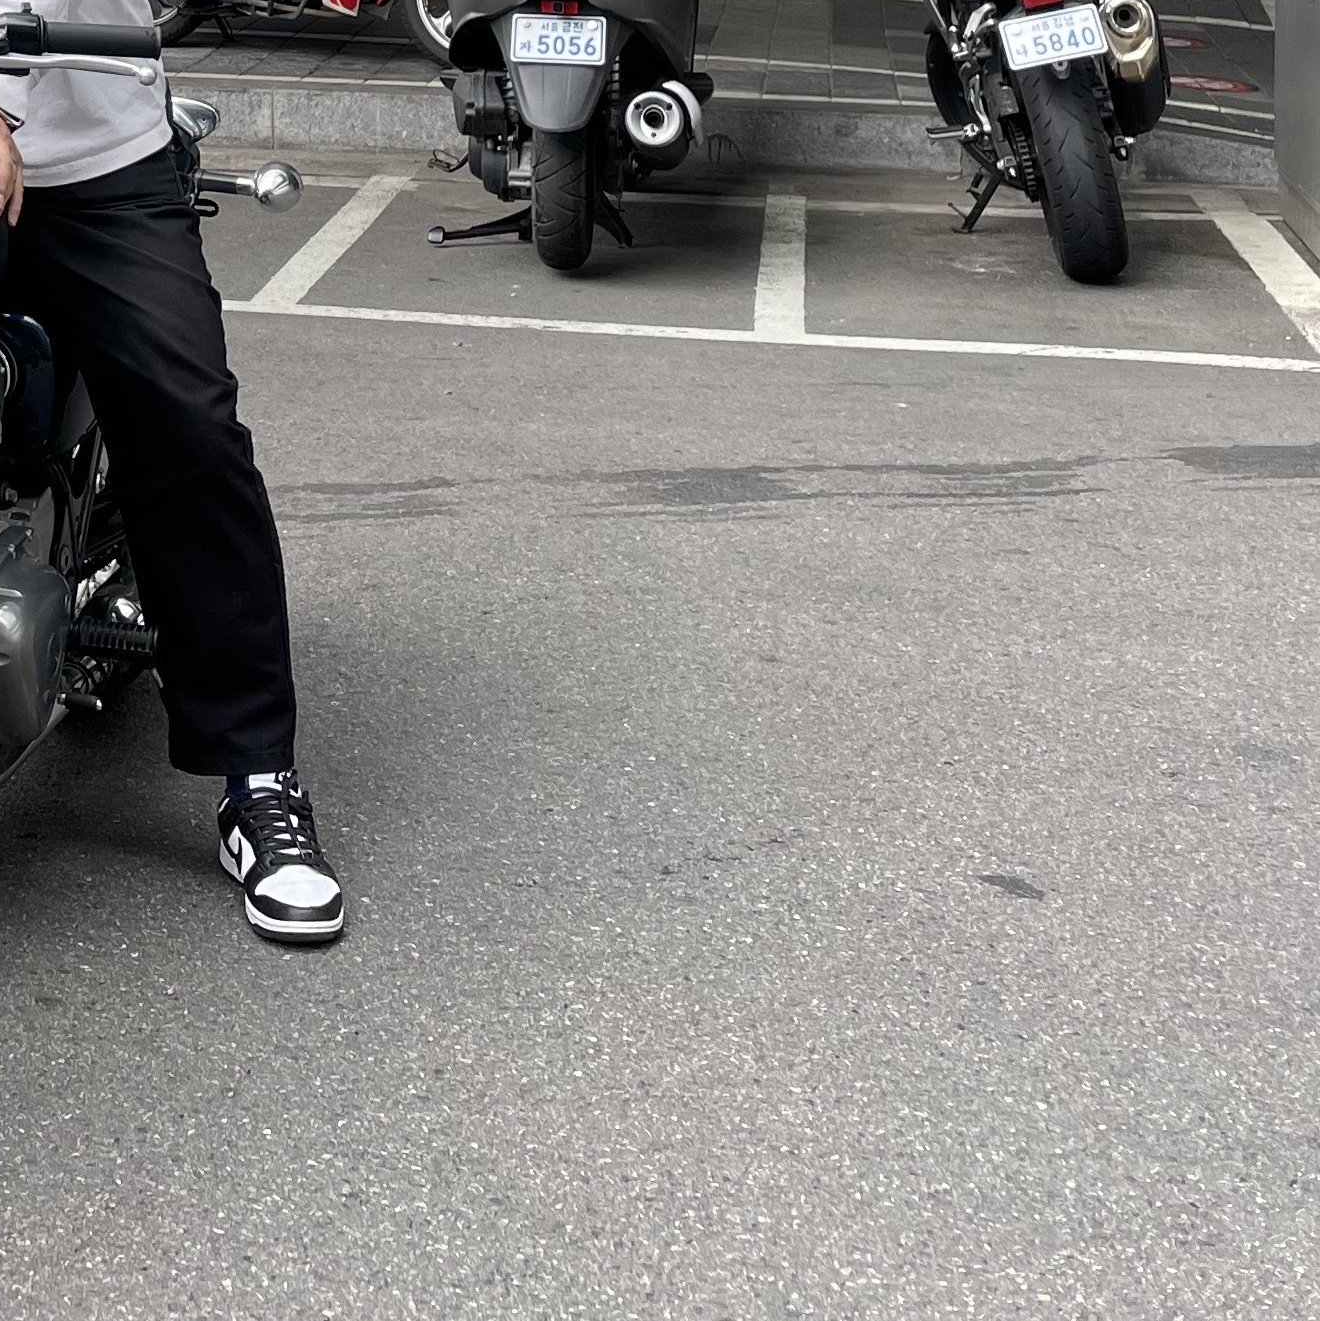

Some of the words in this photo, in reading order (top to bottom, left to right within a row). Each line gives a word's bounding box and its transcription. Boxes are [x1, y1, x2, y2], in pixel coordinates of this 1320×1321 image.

[541, 22, 558, 32] 서울
[1032, 20, 1050, 32] 서울
[519, 40, 532, 53] 자
[537, 34, 597, 57] 5056
[1032, 26, 1096, 56] 5840
